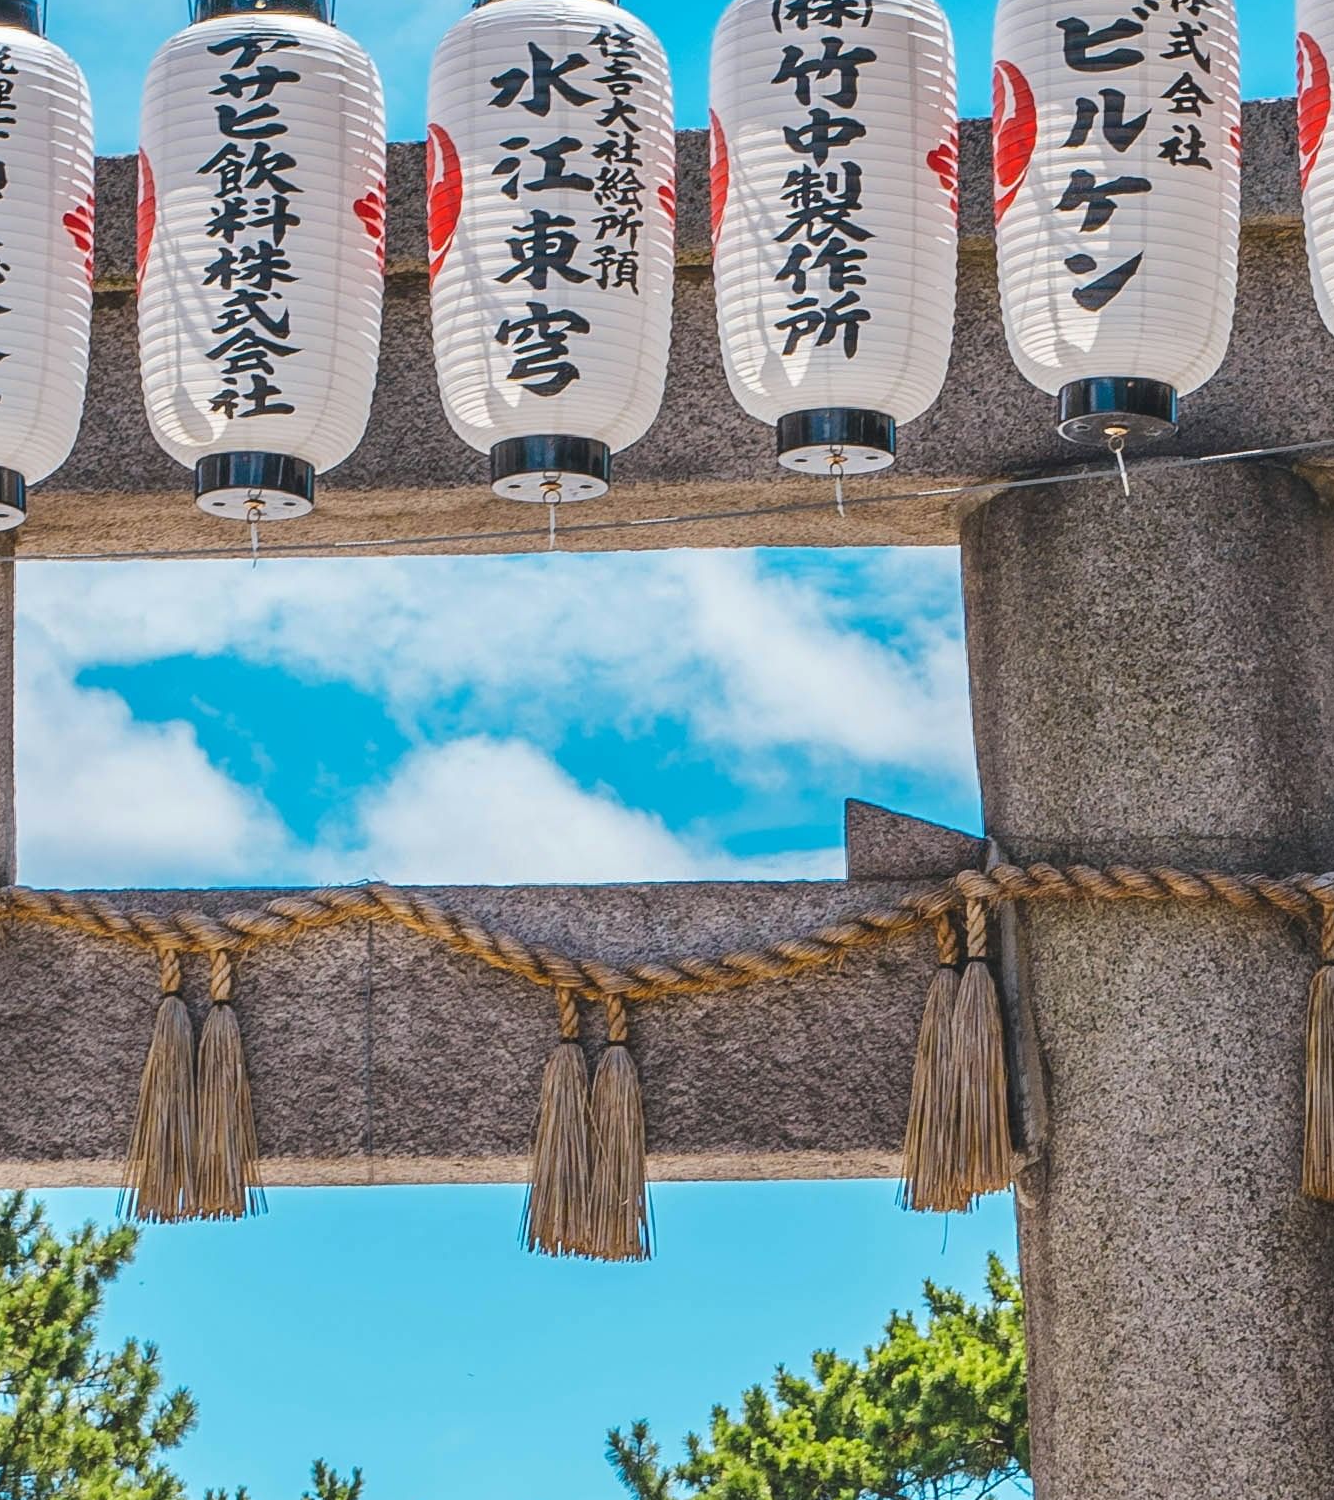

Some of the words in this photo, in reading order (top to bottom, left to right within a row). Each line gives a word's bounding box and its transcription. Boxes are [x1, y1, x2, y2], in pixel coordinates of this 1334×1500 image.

[196, 34, 305, 419] アサヒ飲料株式会社
[588, 23, 646, 296] 住吉大社絵所預
